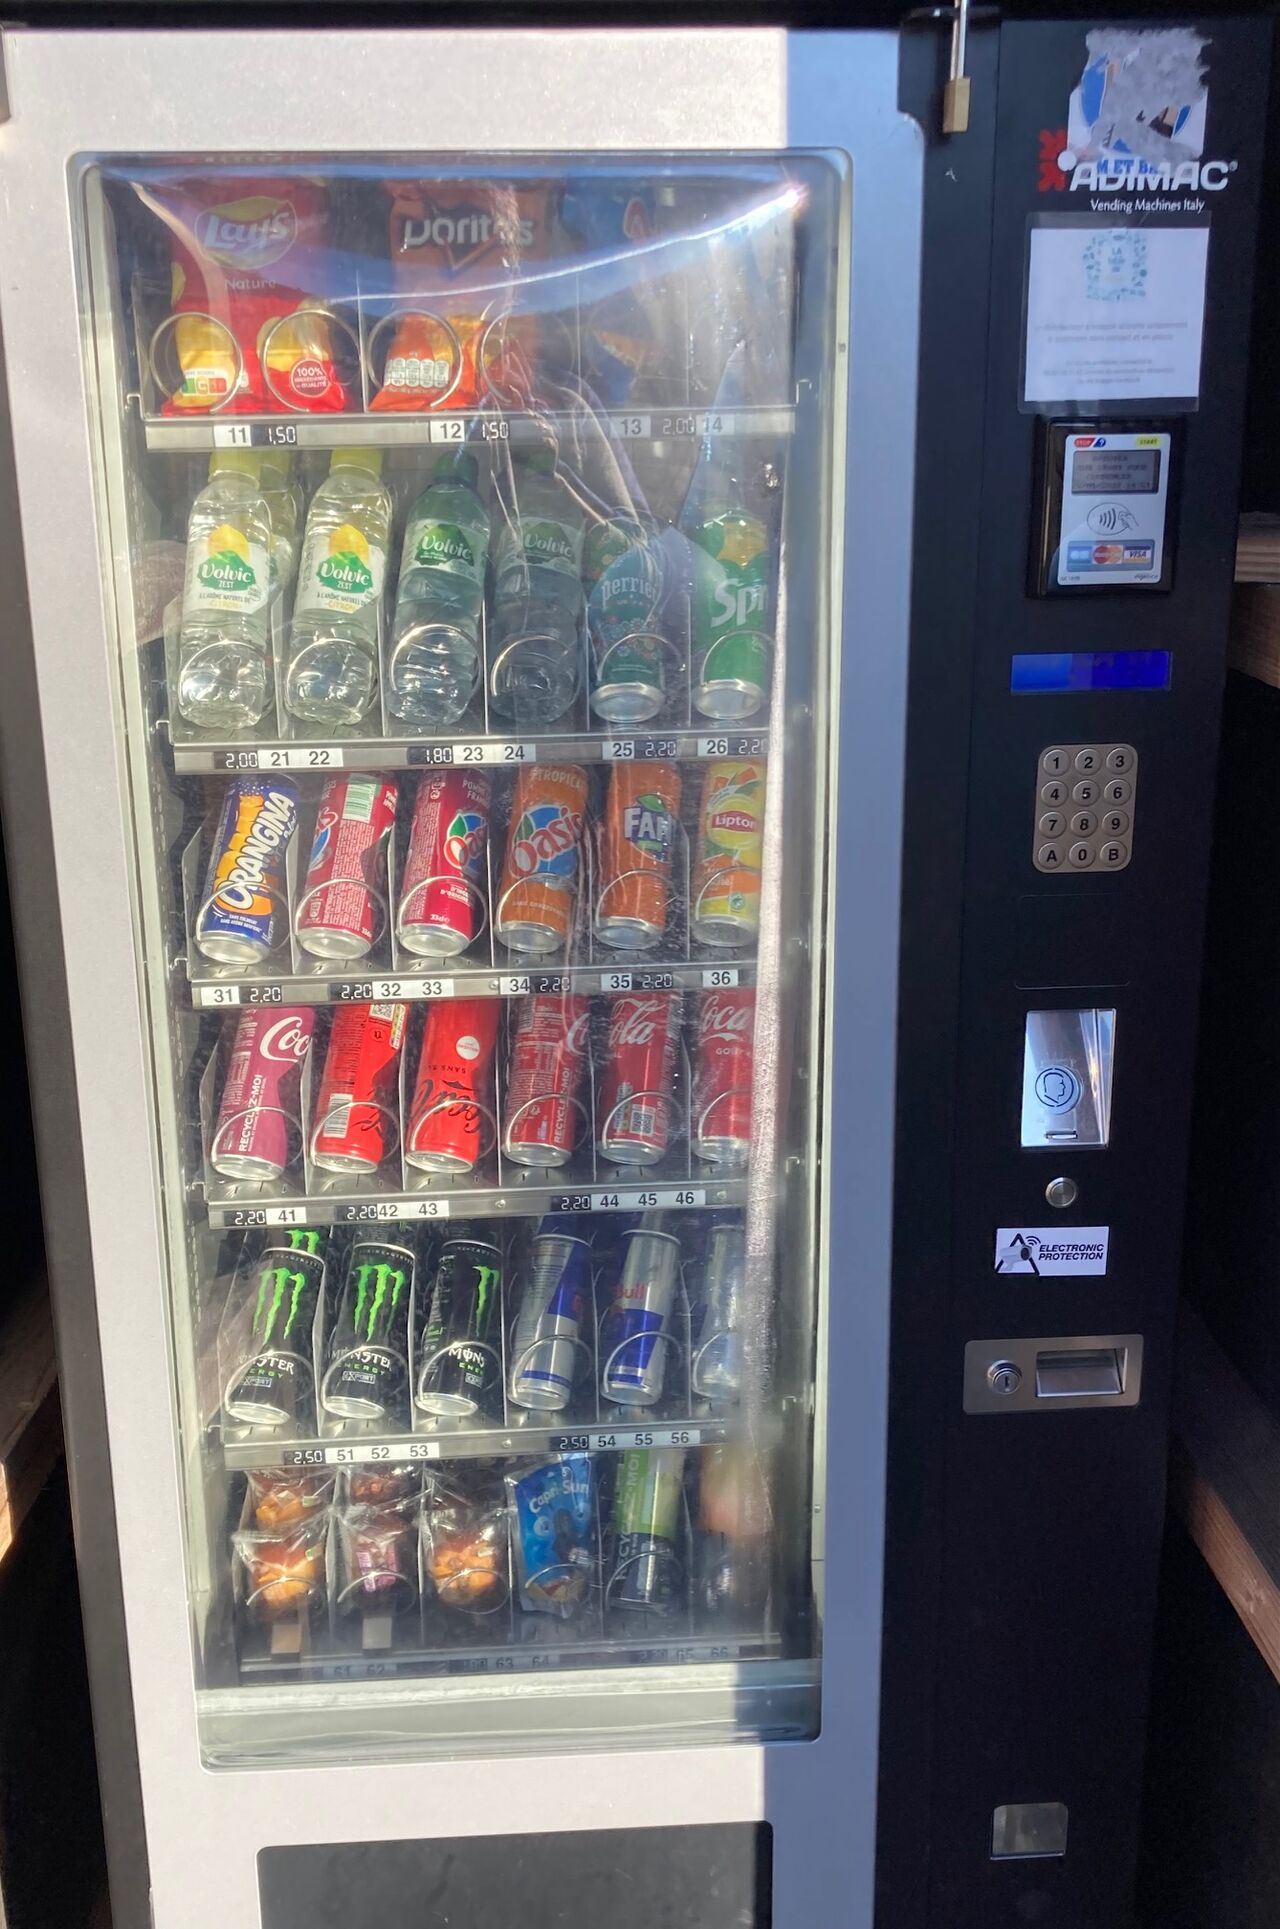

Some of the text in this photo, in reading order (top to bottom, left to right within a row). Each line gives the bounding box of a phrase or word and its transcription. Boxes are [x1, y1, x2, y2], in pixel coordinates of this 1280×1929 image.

[1090, 197, 1205, 214] Vending Machines Italy
[204, 209, 291, 249] Lay's
[404, 213, 534, 246] Dorits
[224, 277, 277, 291] Nature
[297, 367, 324, 377] 100%
[228, 427, 248, 443] 11
[440, 422, 462, 439] 12
[620, 418, 642, 435] 13
[702, 415, 723, 432] 14
[421, 535, 472, 560] Volvic
[524, 533, 573, 557] Volvic
[1128, 550, 1147, 558] VISA
[201, 563, 252, 583] Volvic
[320, 562, 370, 586] Volvic
[270, 752, 290, 766] 21
[308, 750, 331, 765] 22
[463, 747, 484, 761] 23
[504, 746, 525, 760] 24
[612, 742, 632, 757] 25
[706, 739, 727, 754] 26
[1053, 755, 1125, 769] 1 2 3
[1050, 787, 1122, 800] 4 5 6
[1048, 818, 1120, 831] 7 8 9
[216, 791, 295, 910] ORANGINA
[1046, 849, 1119, 862] A 0 B
[213, 989, 232, 1003] 31
[381, 983, 401, 997] 32
[422, 982, 442, 995] 33
[509, 978, 529, 992] 34
[610, 975, 630, 989] 35
[711, 972, 731, 985] 36
[278, 1209, 297, 1221] 41
[378, 1205, 398, 1217] 42
[418, 1203, 438, 1215] 43
[600, 1195, 619, 1208] 44
[638, 1193, 657, 1206] 45
[675, 1192, 694, 1204] 46
[1038, 1252, 1104, 1261] PROTECTION
[1039, 1243, 1104, 1253] ELECTRONIC
[337, 1449, 354, 1460] 51
[370, 1447, 390, 1459] 52
[409, 1445, 428, 1457] 53
[597, 1435, 616, 1447] 54
[634, 1433, 653, 1446] 55
[671, 1431, 689, 1444] 56
